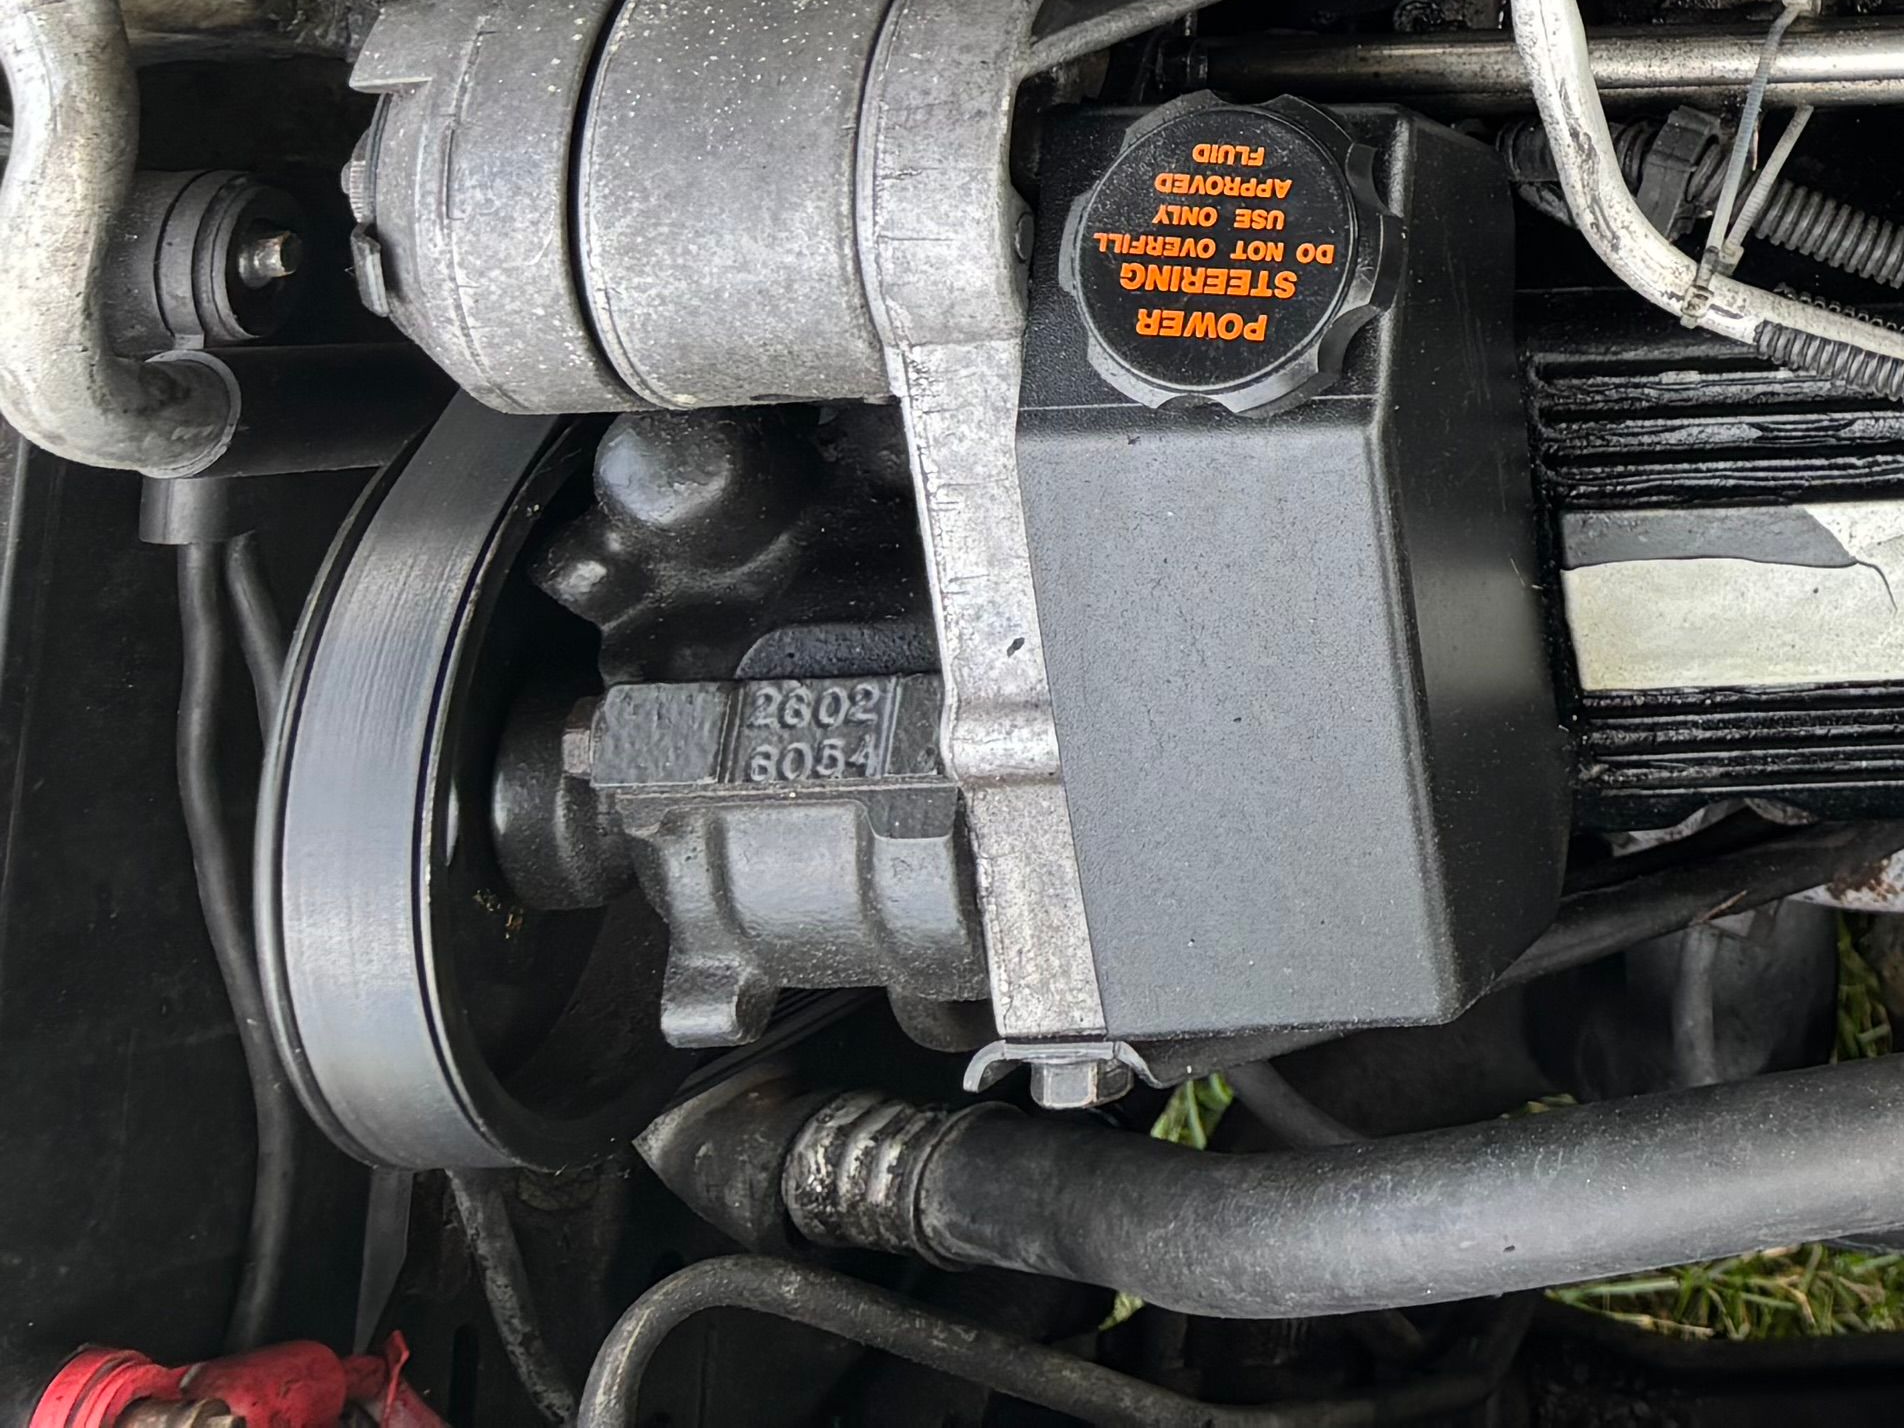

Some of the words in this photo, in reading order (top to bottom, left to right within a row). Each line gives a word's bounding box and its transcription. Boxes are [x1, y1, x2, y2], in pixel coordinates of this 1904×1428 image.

[1192, 143, 1265, 167] FLUID
[1154, 172, 1292, 199] APPROVED
[1151, 204, 1218, 227] ONLY
[1234, 208, 1285, 230] USE
[1093, 232, 1216, 259] OVERFILL
[1231, 241, 1284, 262] NOT
[1295, 244, 1335, 264] DO
[1119, 262, 1298, 299] STEERING
[1136, 309, 1268, 342] POWER
